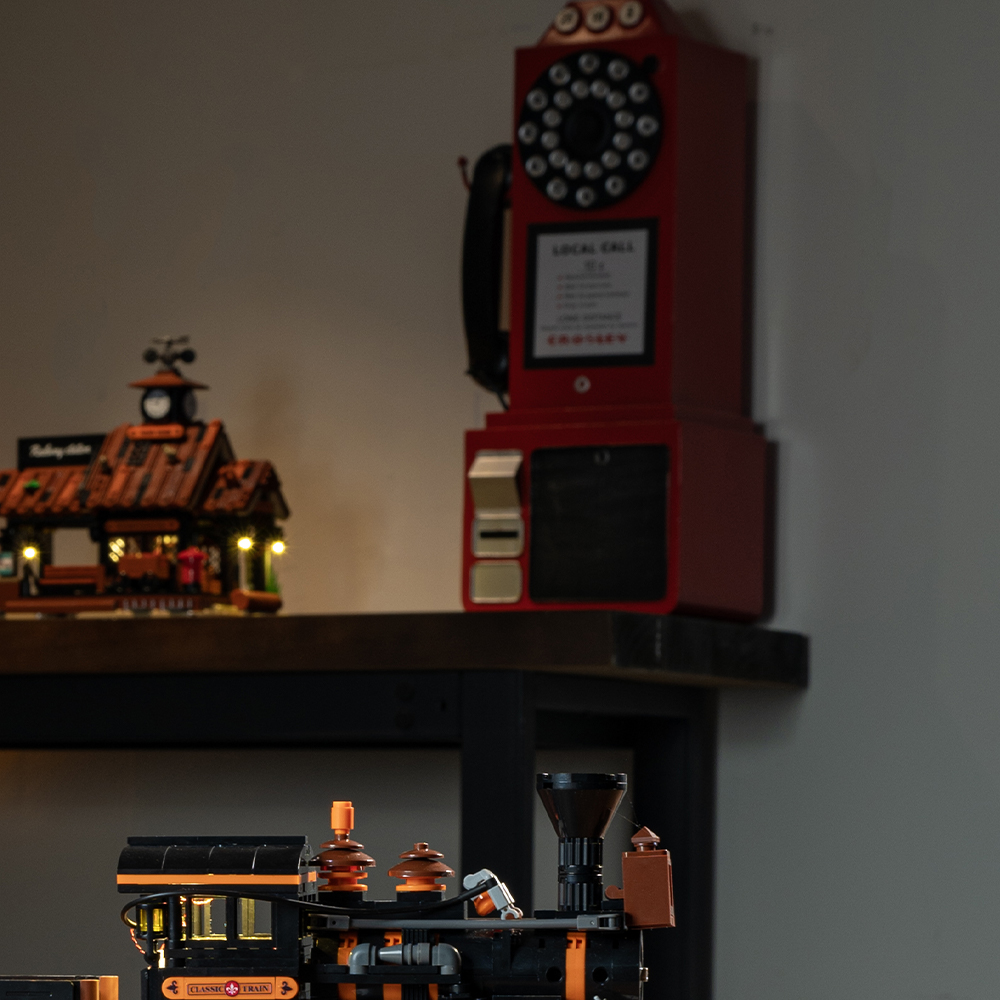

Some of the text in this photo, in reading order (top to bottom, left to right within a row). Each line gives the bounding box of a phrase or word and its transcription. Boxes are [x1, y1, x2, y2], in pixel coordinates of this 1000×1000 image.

[552, 239, 634, 257] LOCAL CALL
[547, 333, 627, 346] CROSLEY
